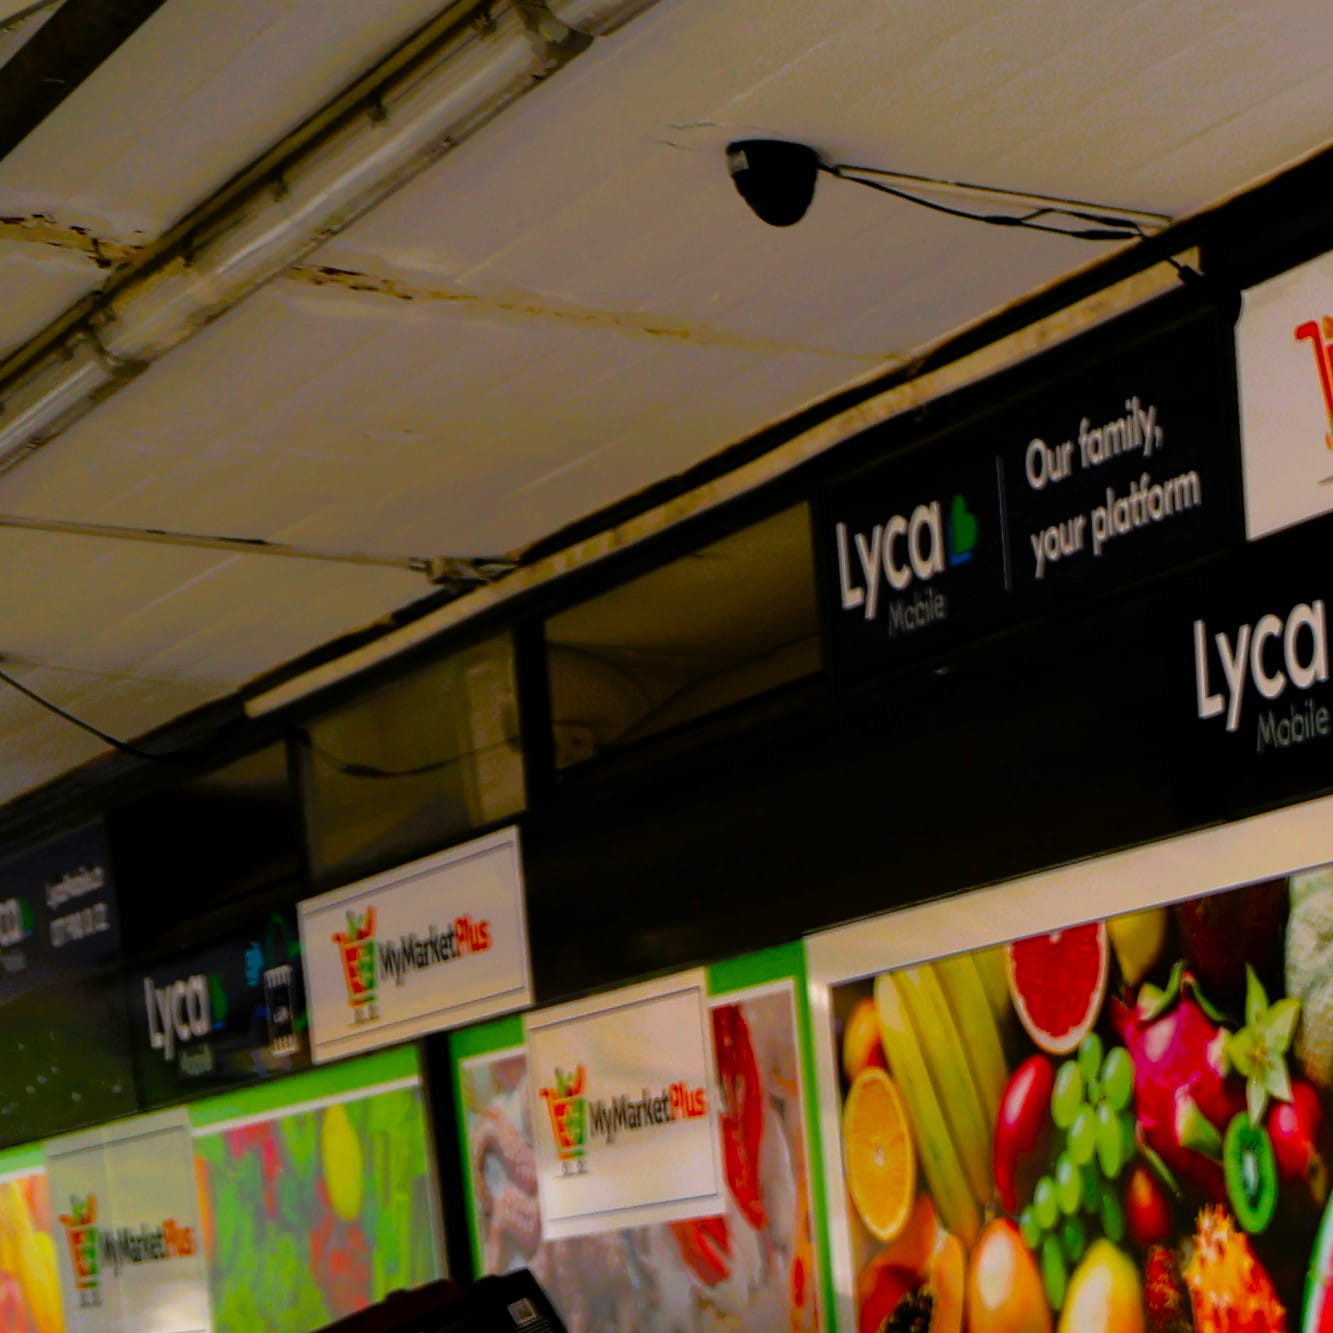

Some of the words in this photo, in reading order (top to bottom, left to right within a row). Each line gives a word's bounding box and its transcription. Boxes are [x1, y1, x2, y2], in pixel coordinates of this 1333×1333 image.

[1025, 435, 1072, 490] Our
[1076, 395, 1163, 480] family,
[836, 495, 943, 620] Lyca
[1031, 502, 1088, 579] your
[1091, 464, 1199, 557] platform
[888, 588, 944, 634] Mobile
[1193, 597, 1328, 731] Lyca
[1257, 701, 1330, 752] Mobile
[380, 914, 492, 982] MyMarketPlus
[144, 973, 211, 1061] Lyca
[590, 1080, 706, 1146] MyMarketPlus
[100, 1221, 196, 1275] MyMarketPlus
